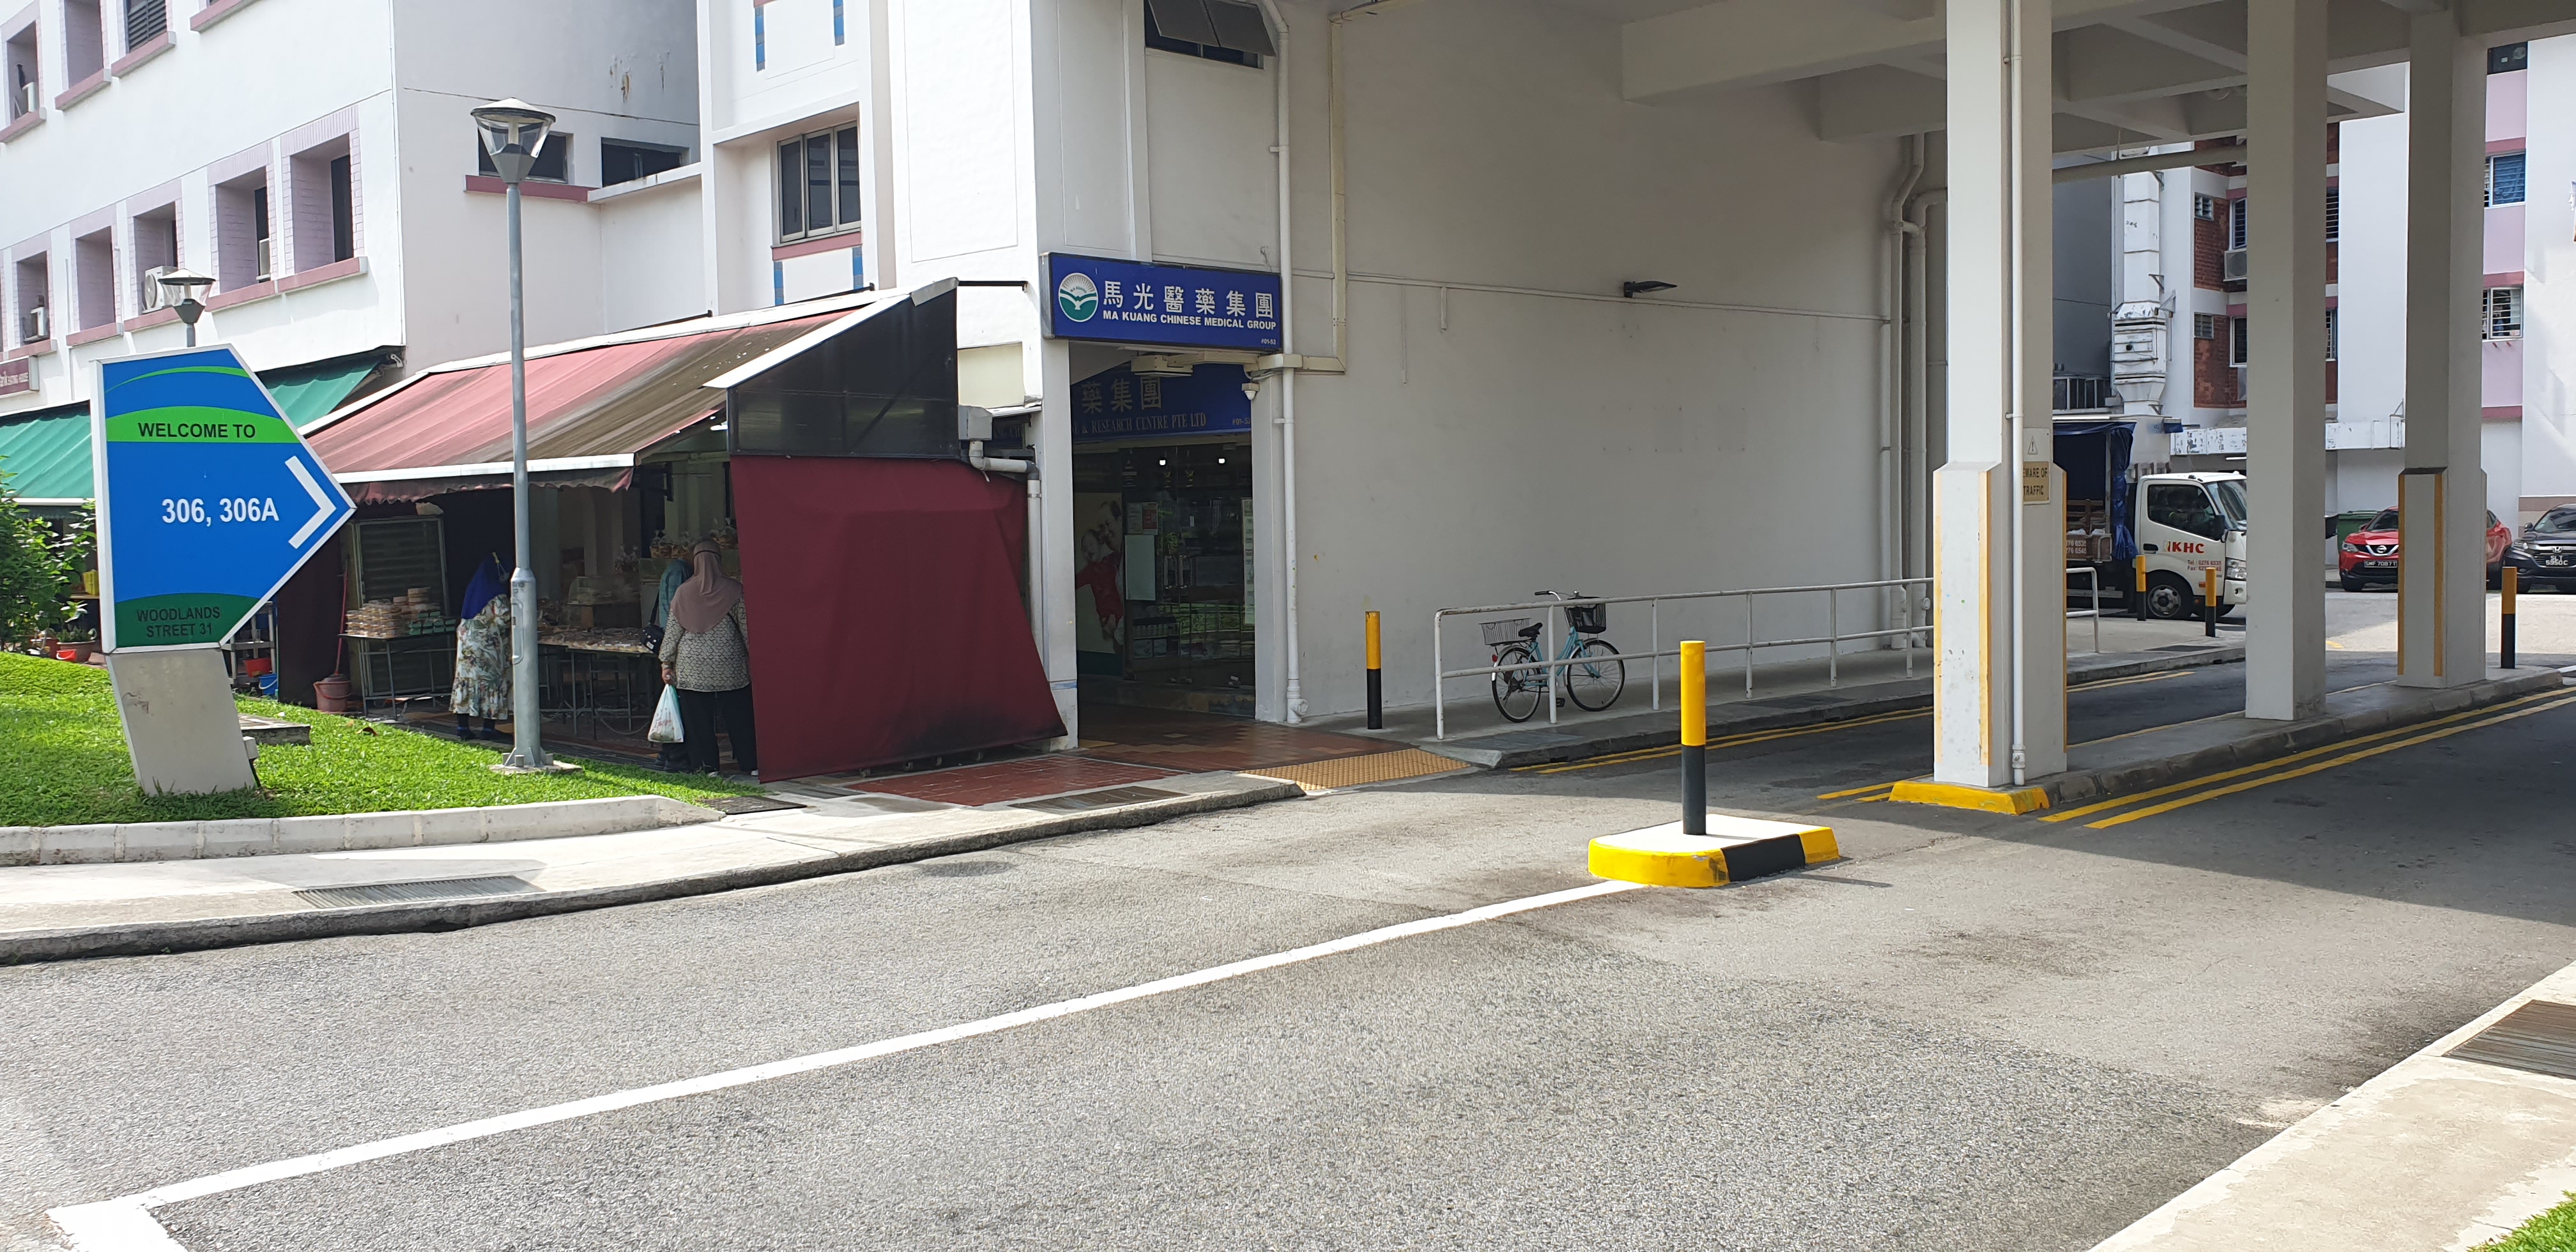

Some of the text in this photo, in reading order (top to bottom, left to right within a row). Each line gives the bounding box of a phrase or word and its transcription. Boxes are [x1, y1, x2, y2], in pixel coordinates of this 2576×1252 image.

[1103, 280, 1273, 319] 馬光醫藥集團
[1103, 310, 1276, 330] MA KUANG CHINESE MEDICAL GROUP
[137, 422, 256, 438] WELCOME TO
[1091, 418, 1133, 434] RESEARCH
[1135, 415, 1169, 431] CENTRE
[1172, 414, 1188, 429] PTE
[1190, 413, 1207, 427] LTD
[2023, 467, 2048, 478] EWARE OF
[2023, 485, 2044, 496] TRAFFIC
[162, 498, 280, 527] 306, 306A
[136, 606, 220, 622] WOODLANDS
[146, 622, 212, 637] STREET 31
